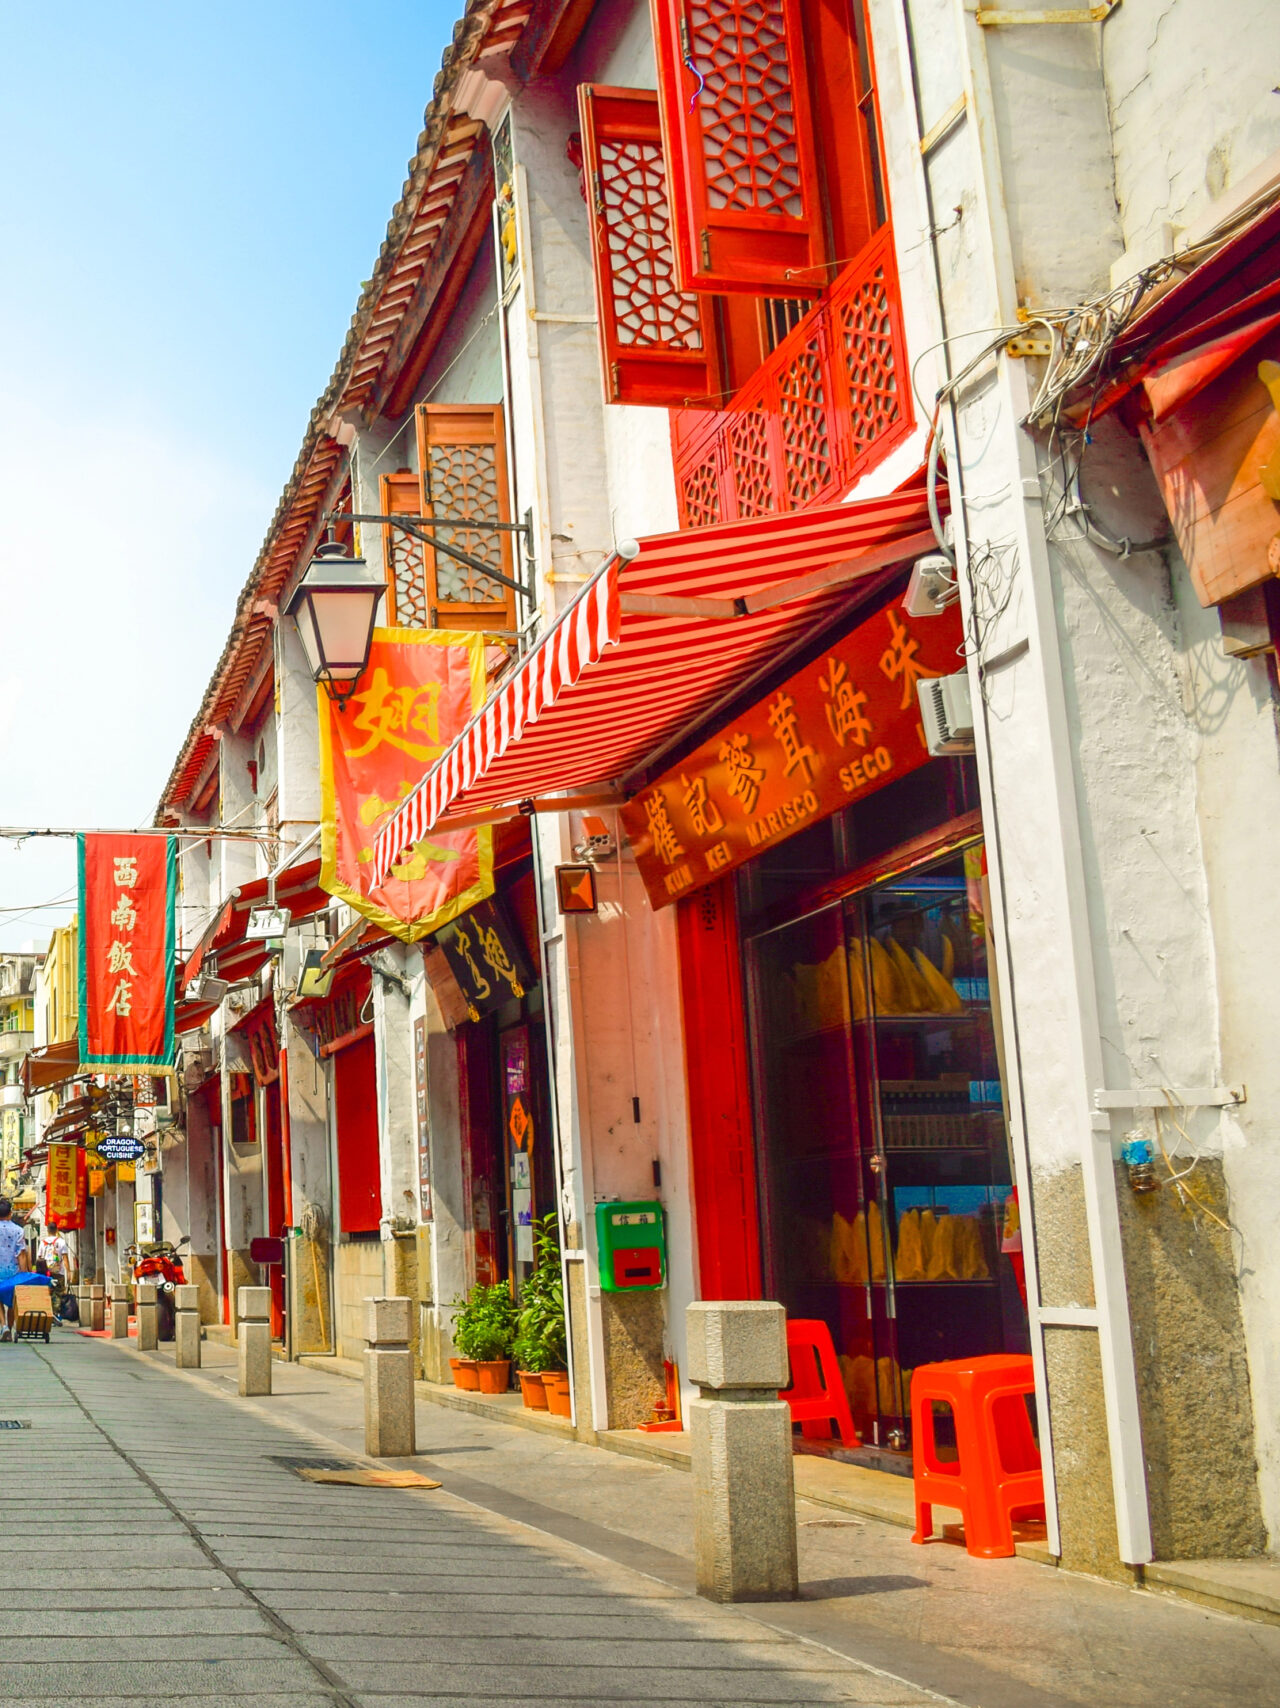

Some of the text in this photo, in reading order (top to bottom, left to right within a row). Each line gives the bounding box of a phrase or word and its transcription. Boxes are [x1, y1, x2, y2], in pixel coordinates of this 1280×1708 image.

[663, 746, 892, 895] KUN KEI MARISCO SECO
[105, 857, 139, 1017] 西南飯店
[619, 1213, 648, 1225] 信箱
